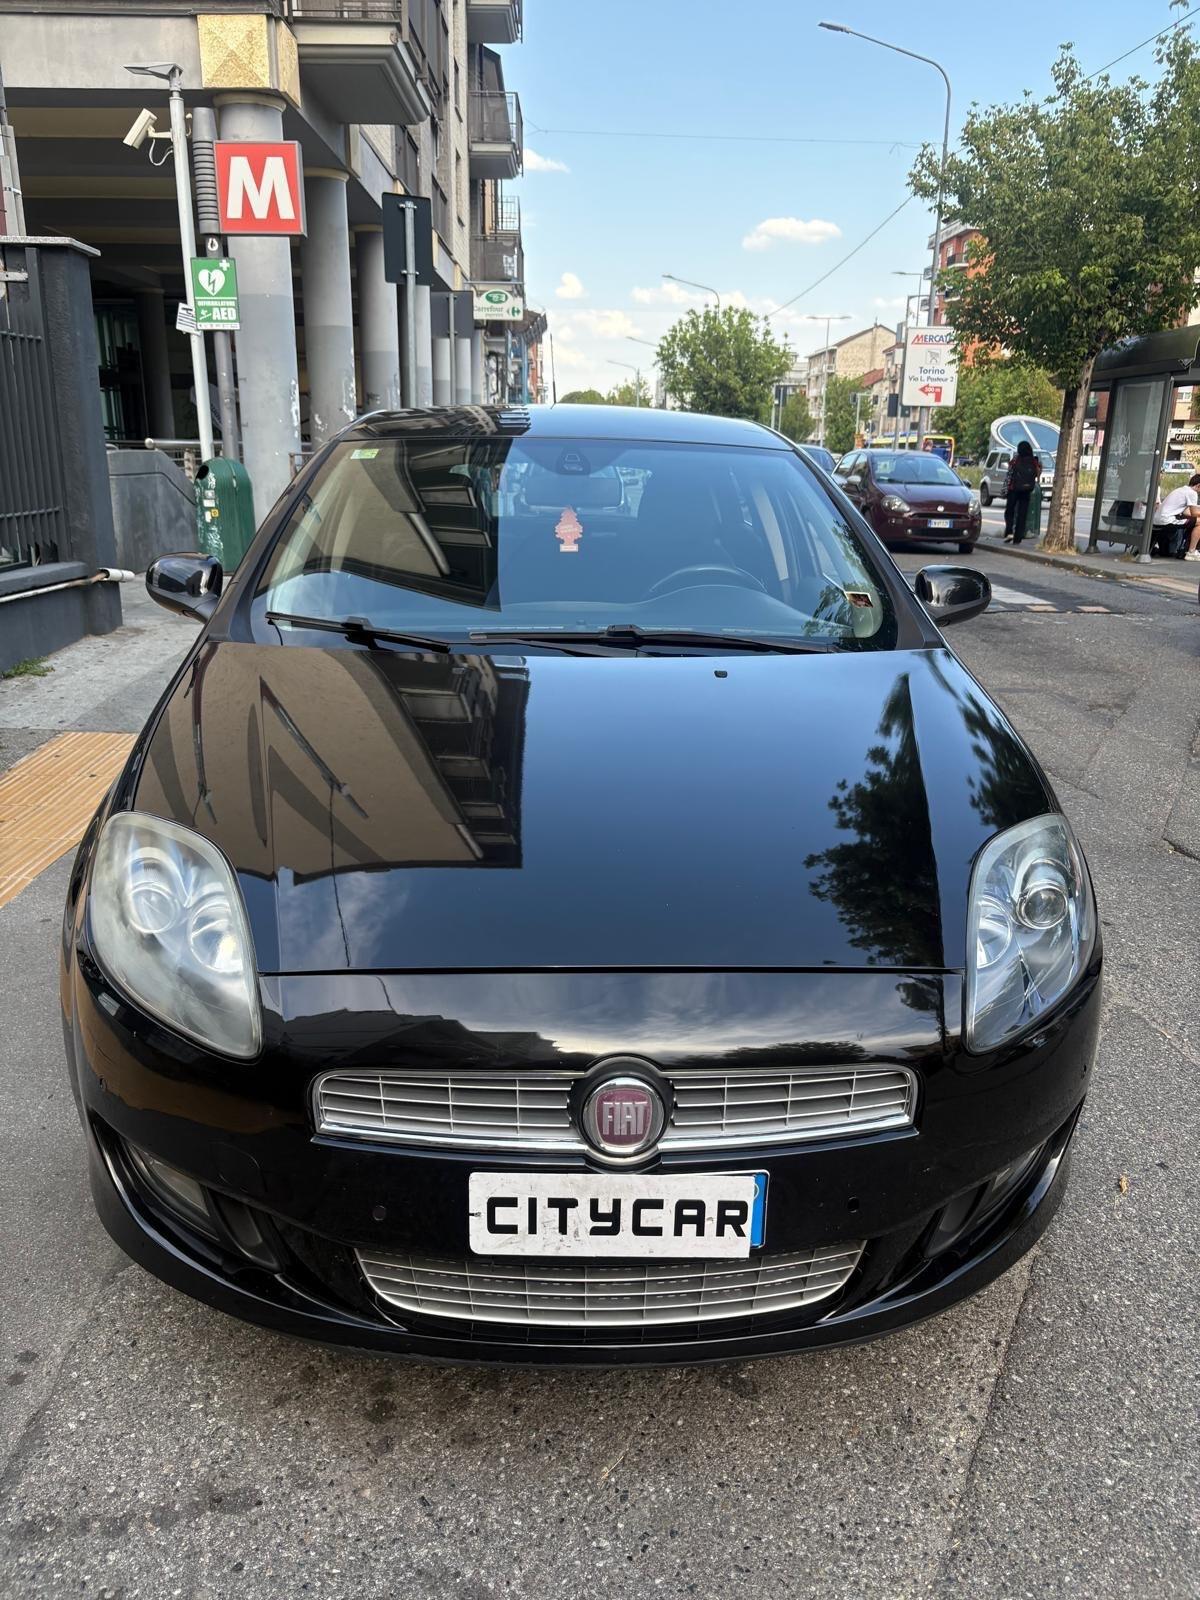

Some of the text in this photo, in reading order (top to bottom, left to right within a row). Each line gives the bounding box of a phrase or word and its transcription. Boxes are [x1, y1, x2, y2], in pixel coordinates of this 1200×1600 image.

[226, 156, 296, 219] M
[212, 307, 237, 321] AED
[919, 366, 945, 375] Torino
[927, 375, 948, 383] Pasteur
[602, 1101, 648, 1136] FIAT
[486, 1197, 748, 1237] CITYCAR
